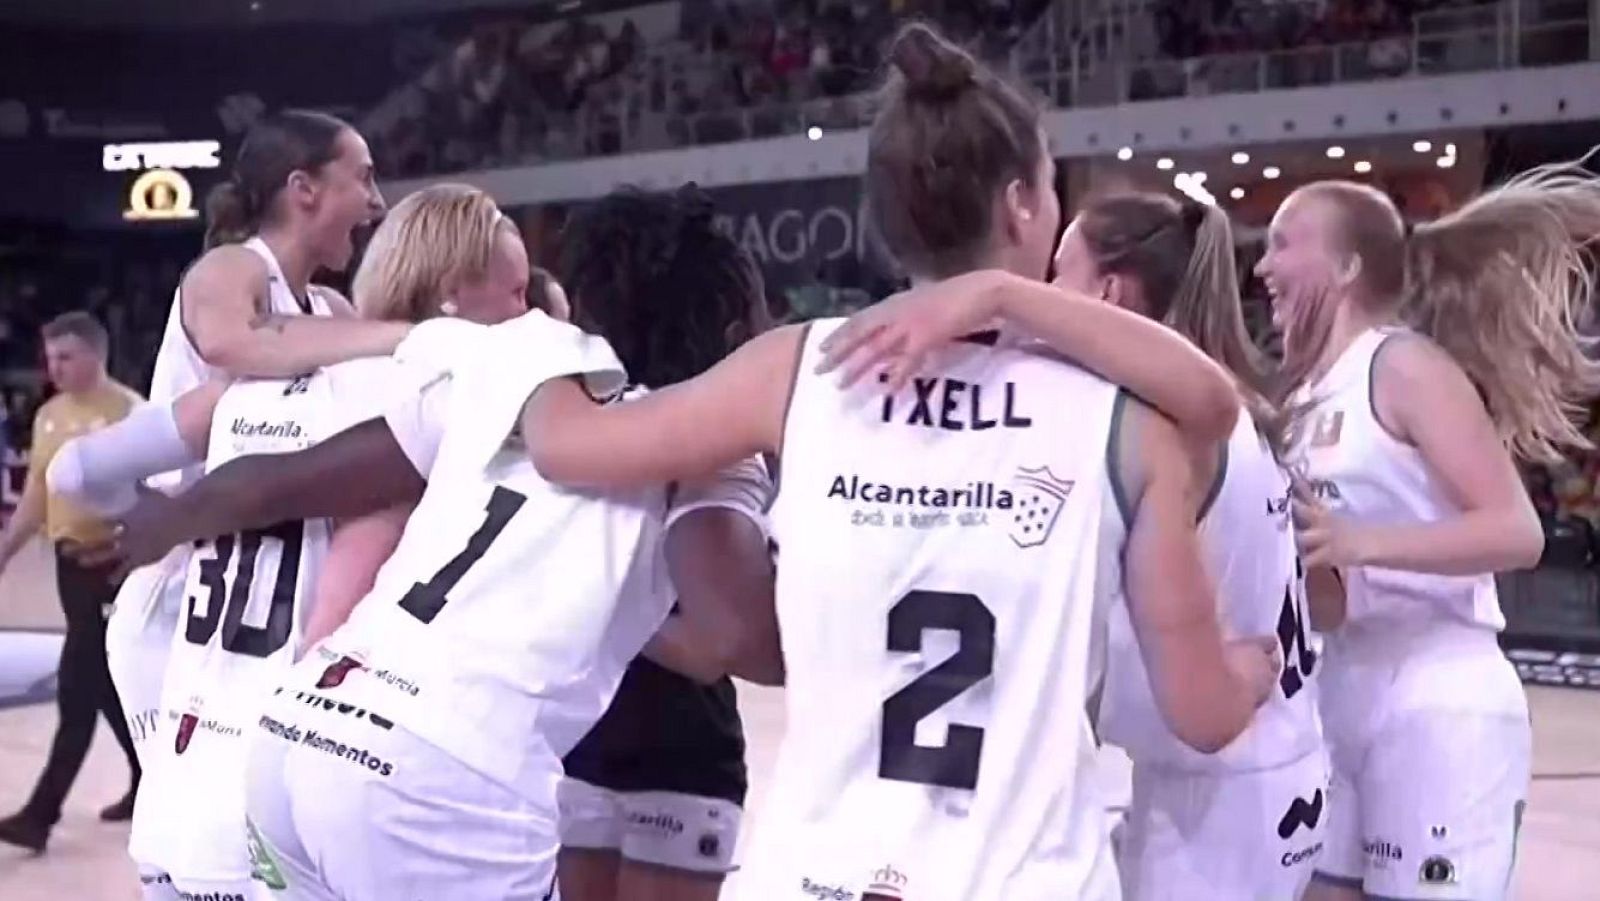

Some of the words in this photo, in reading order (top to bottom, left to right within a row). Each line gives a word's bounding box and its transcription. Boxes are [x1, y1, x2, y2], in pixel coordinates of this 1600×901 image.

[397, 485, 528, 624] 1
[827, 475, 1014, 510] Alcantarilla
[185, 519, 304, 658] 30
[301, 730, 393, 776] Momentos
[878, 589, 996, 790] 2
